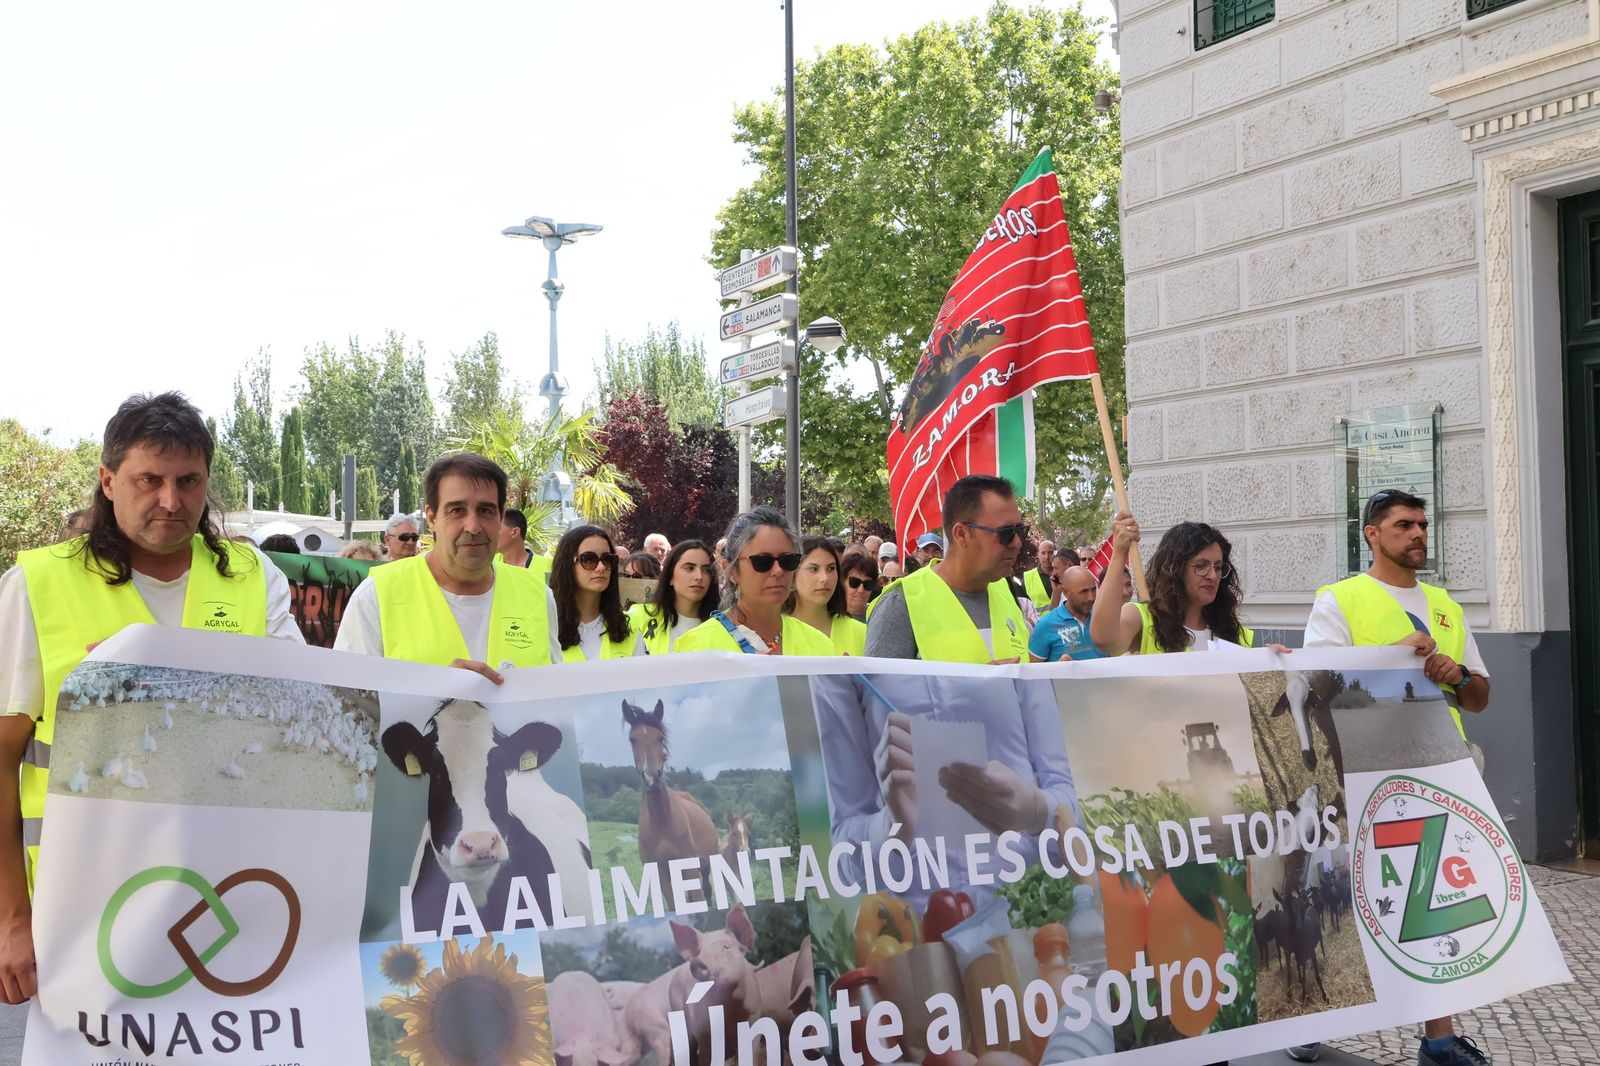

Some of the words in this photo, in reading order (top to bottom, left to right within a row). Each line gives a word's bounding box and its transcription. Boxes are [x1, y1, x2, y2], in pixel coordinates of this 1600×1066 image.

[745, 304, 782, 324] SALAMANCA
[750, 346, 780, 361] TORDESILLAS
[750, 356, 780, 372] VALLADOLID
[745, 398, 771, 414] Hospitales
[912, 361, 1016, 471] ZAMORA
[204, 619, 240, 628] AGRYGAL
[1367, 780, 1415, 818] AGRICULTORES
[1419, 785, 1427, 796] Y
[1360, 824, 1368, 842] DE
[1432, 791, 1505, 849] GANADEROS
[399, 881, 487, 944] LA
[502, 823, 949, 934] ALIMENTACIÓN
[964, 829, 1027, 886] ES
[1038, 823, 1154, 879] COSA
[1159, 817, 1219, 869] DE
[1221, 805, 1342, 860] TODOS
[1380, 853, 1403, 889] A
[1441, 855, 1477, 889] G
[1502, 854, 1521, 902] LIBRES
[1355, 849, 1382, 938] ASOCIACIÓN
[1431, 952, 1489, 979] ZAMORA
[668, 981, 904, 1066] Únete
[925, 992, 964, 1055] a
[980, 950, 1239, 1046] nosotros
[77, 1007, 305, 1057] UNASPI
